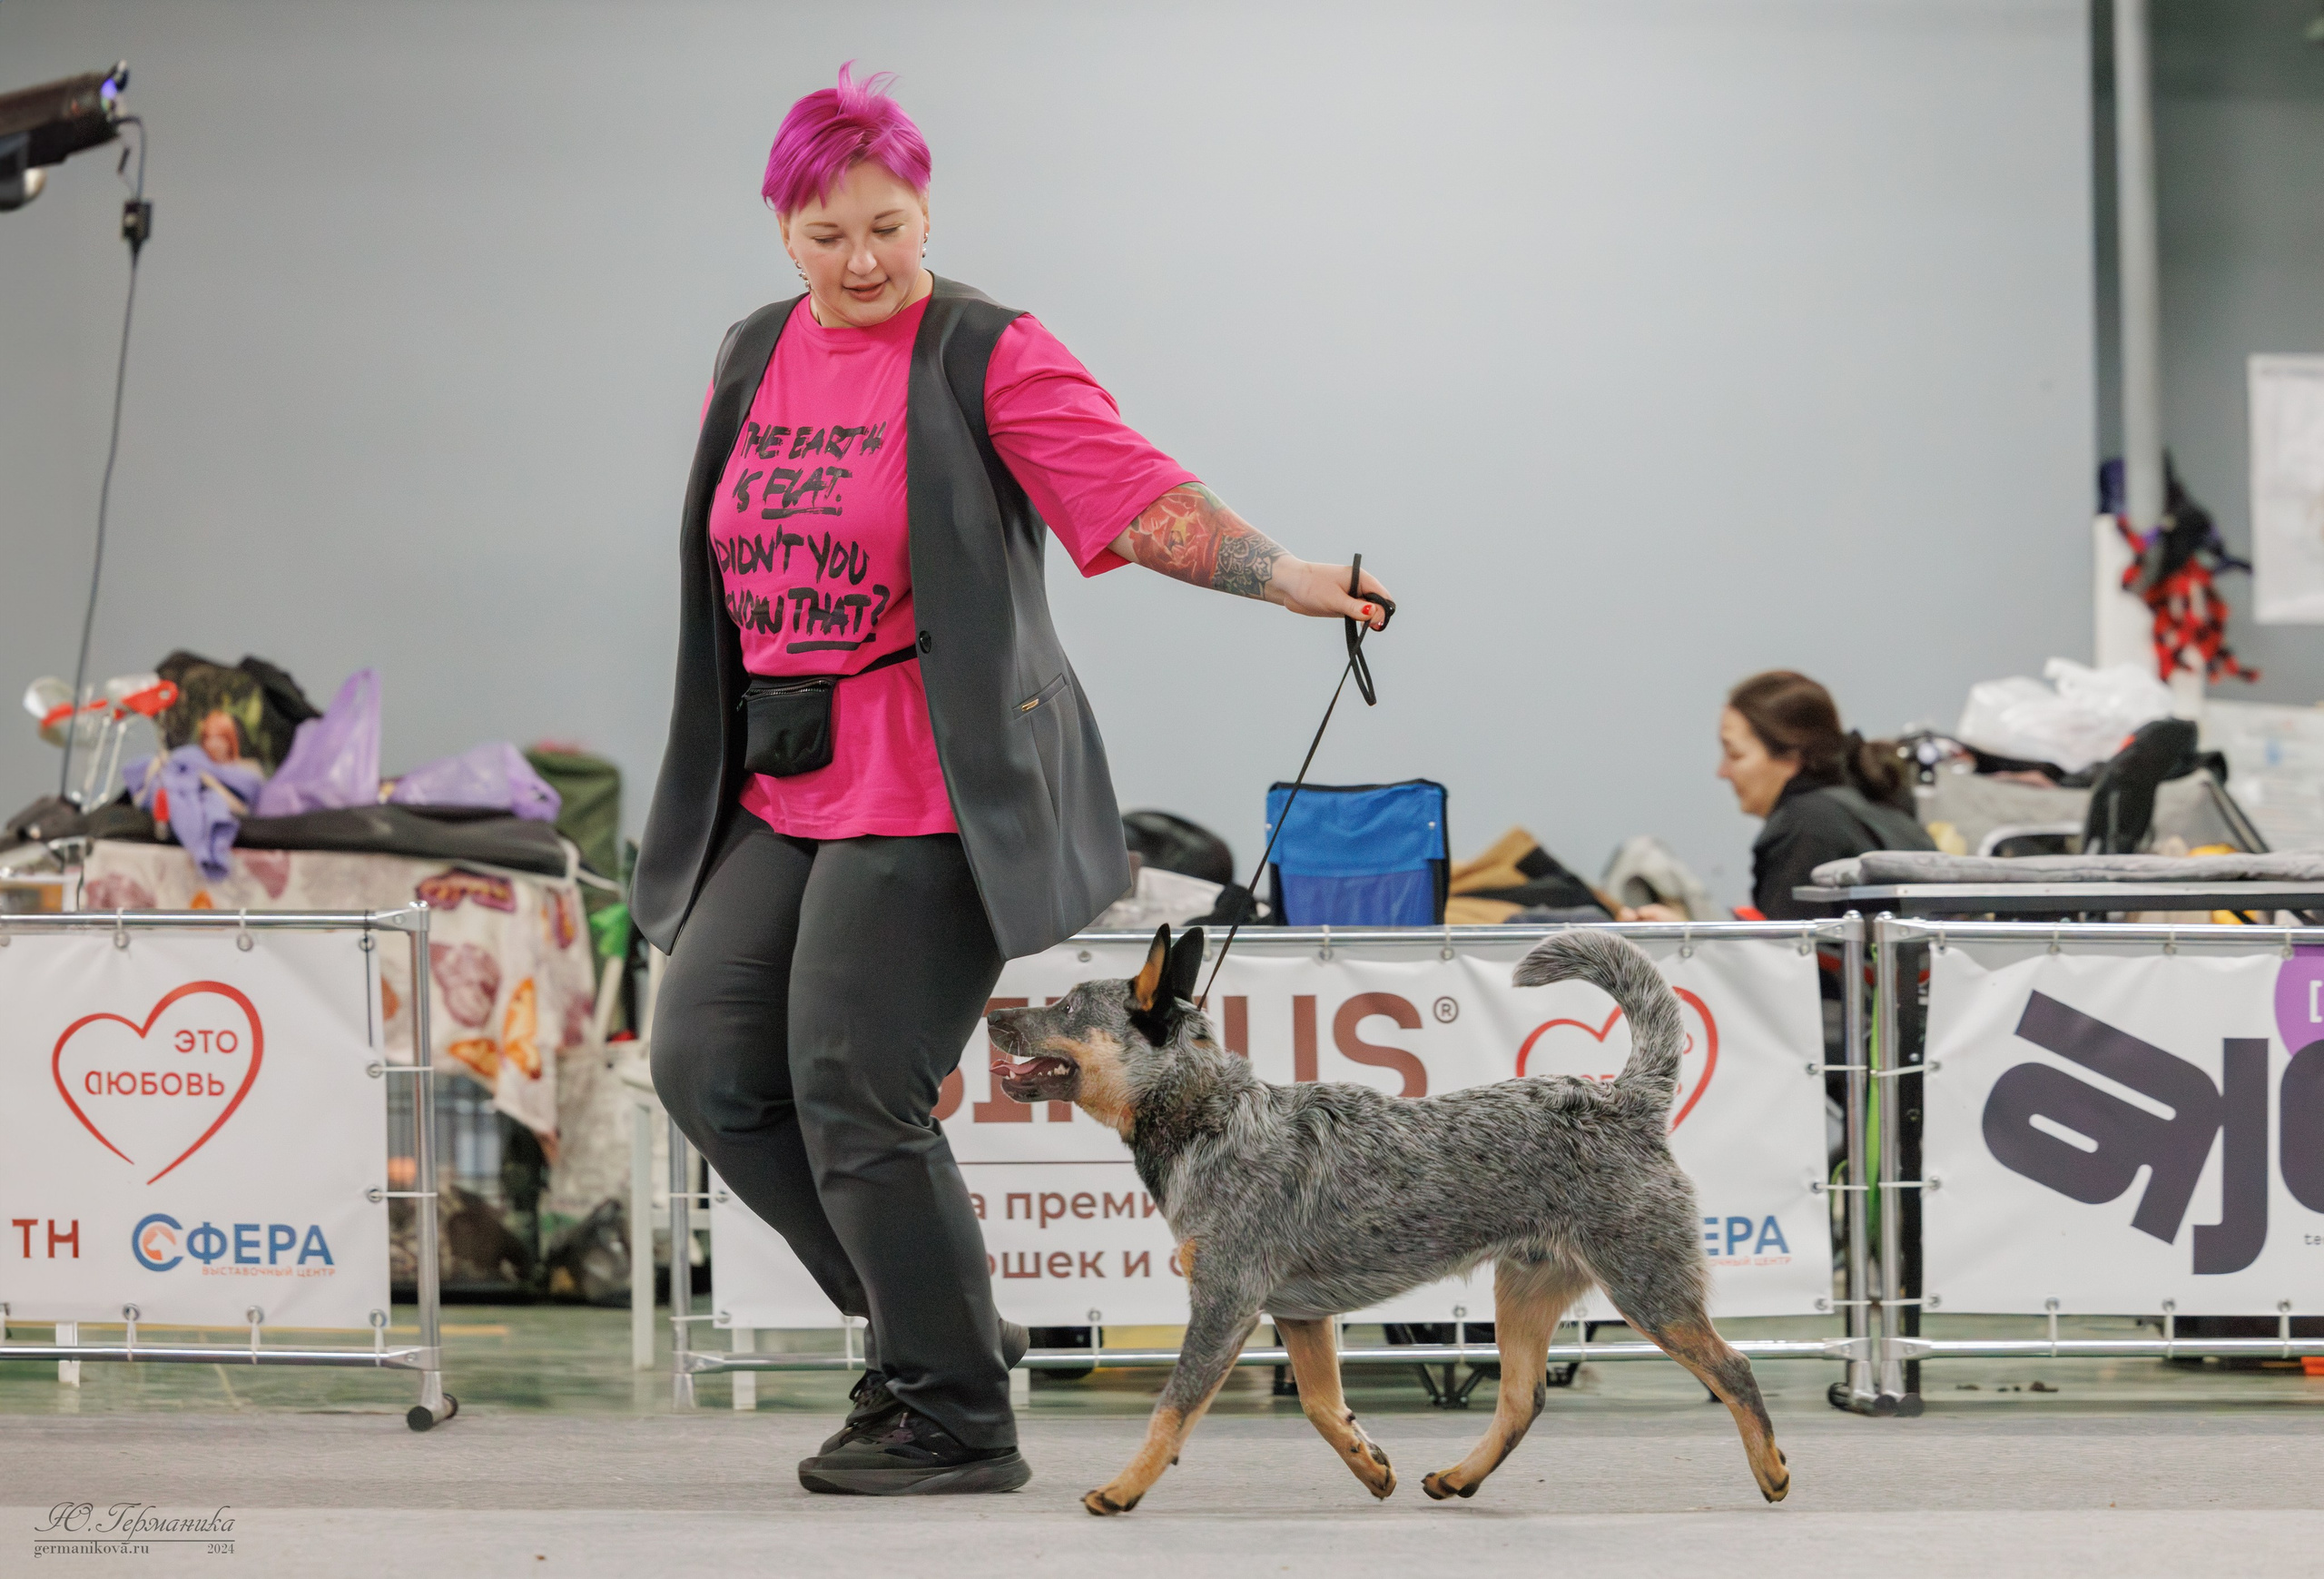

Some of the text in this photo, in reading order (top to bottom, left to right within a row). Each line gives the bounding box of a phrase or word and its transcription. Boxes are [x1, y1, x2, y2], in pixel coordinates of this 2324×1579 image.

[788, 420, 886, 461] EARTH
[732, 468, 763, 514] IS
[714, 524, 871, 586] DIDN'T YOU
[787, 583, 891, 637] THAT?
[173, 1029, 239, 1054] ЭТО
[132, 1213, 335, 1272] СФЕРА
[1122, 1249, 1151, 1278] и
[296, 1268, 336, 1278] ЦЕНТР
